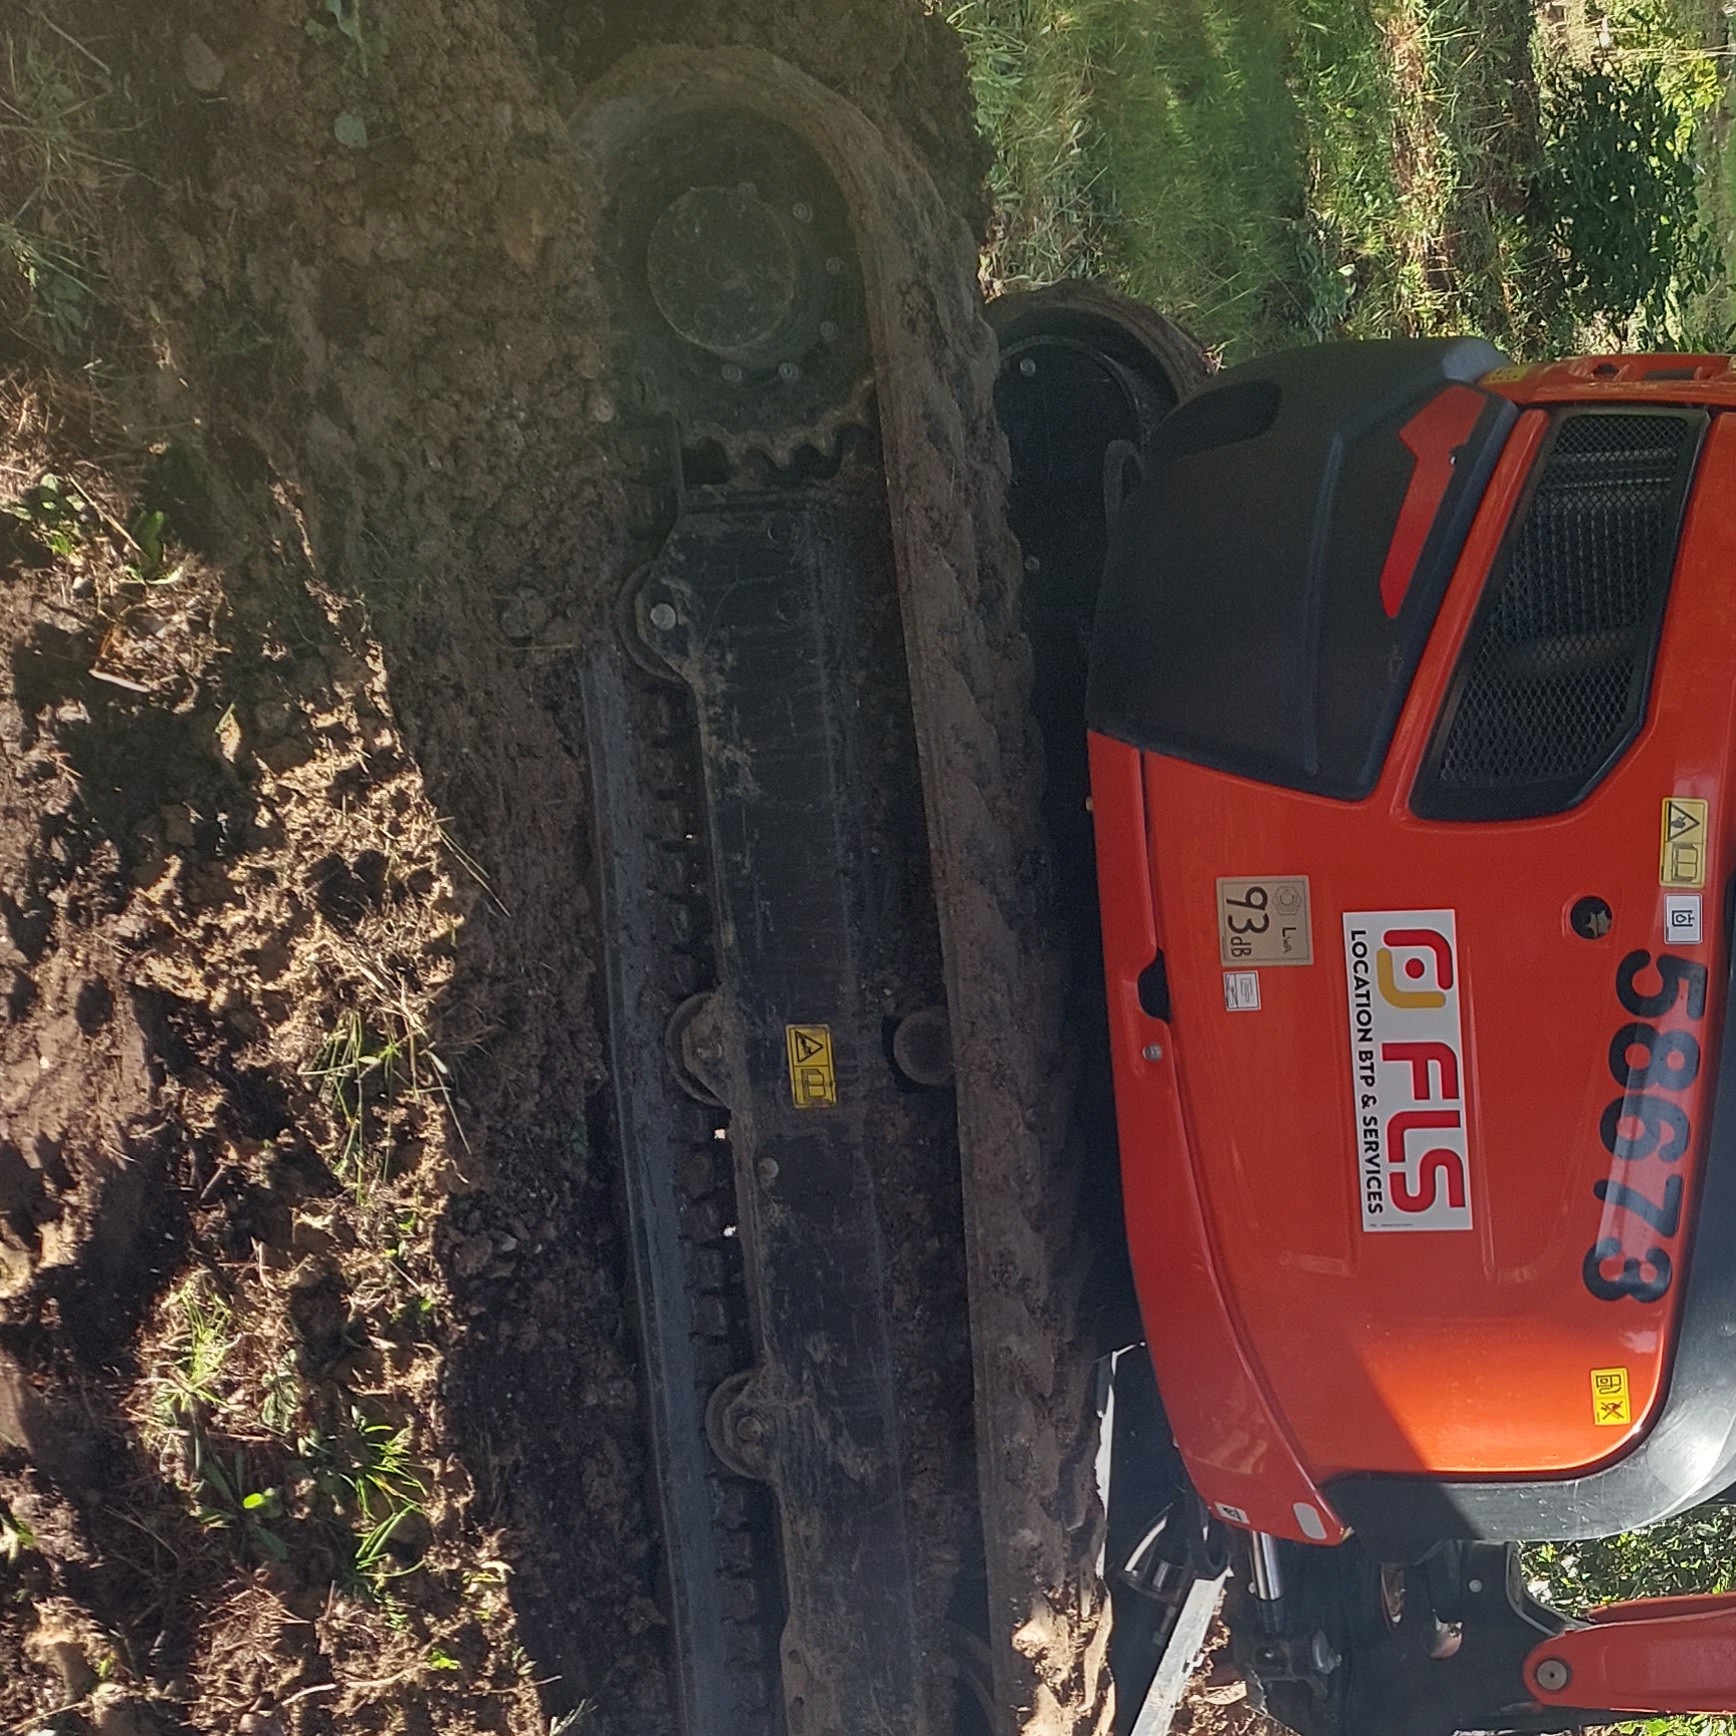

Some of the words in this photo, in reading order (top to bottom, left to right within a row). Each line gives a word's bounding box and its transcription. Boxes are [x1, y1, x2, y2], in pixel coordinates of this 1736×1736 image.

[1226, 886, 1270, 934] 93
[1230, 936, 1252, 958] dB
[1350, 929, 1374, 1043] LOCATION
[1357, 1048, 1376, 1089] BTP
[1360, 1094, 1378, 1110] &
[1381, 1041, 1466, 1214] FLS
[1581, 948, 1709, 1306] 58673
[1362, 1114, 1384, 1215] SERVICES
